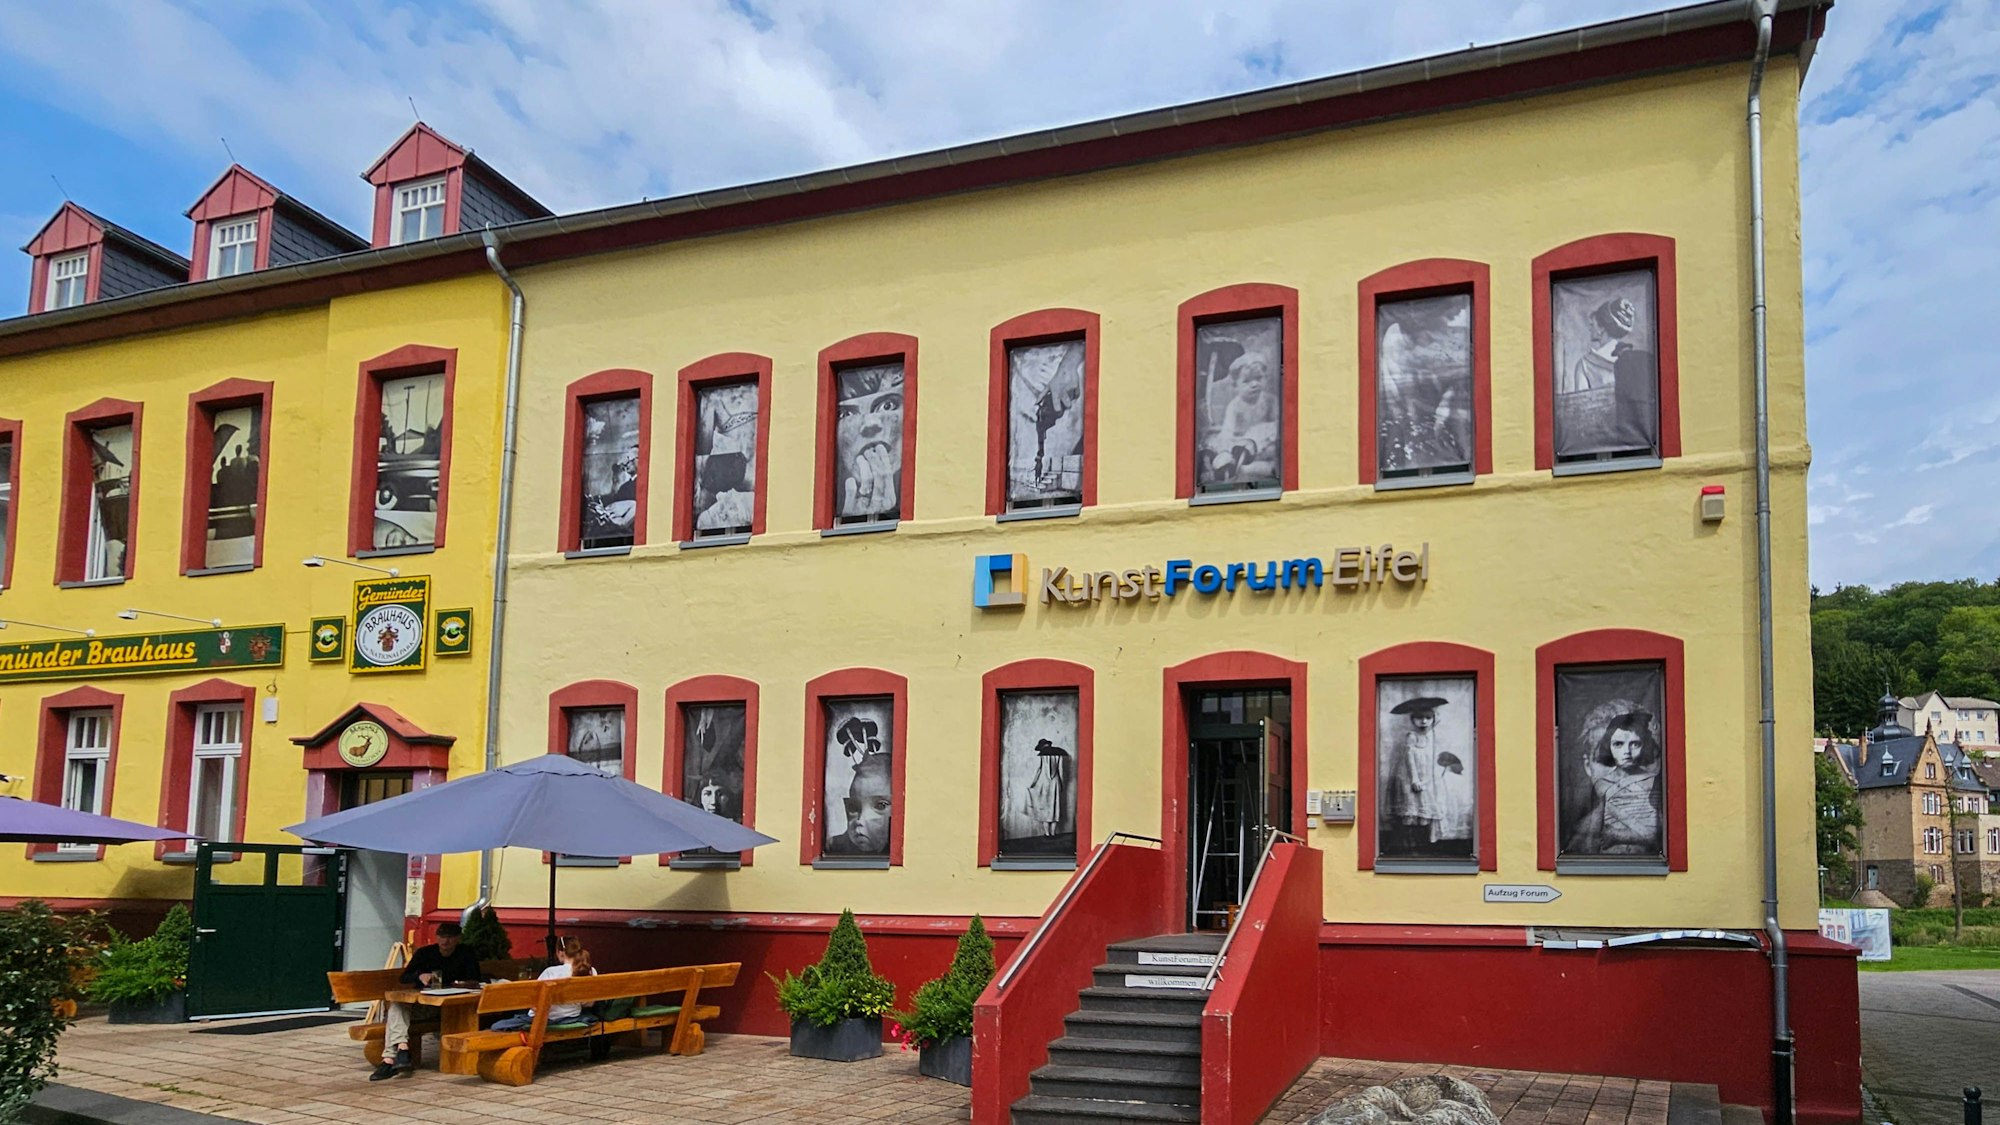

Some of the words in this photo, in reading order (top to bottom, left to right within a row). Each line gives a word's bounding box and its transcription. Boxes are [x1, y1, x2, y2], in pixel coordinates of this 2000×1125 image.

[358, 586, 425, 610] Gemünder
[365, 609, 415, 632] BRAUHAUS
[86, 637, 196, 664] Brauhaus
[368, 641, 415, 660] NATIONALPARK
[1488, 889, 1518, 898] Aufzug
[1520, 889, 1549, 897] Forum
[1151, 954, 1217, 965] KunstForumEife
